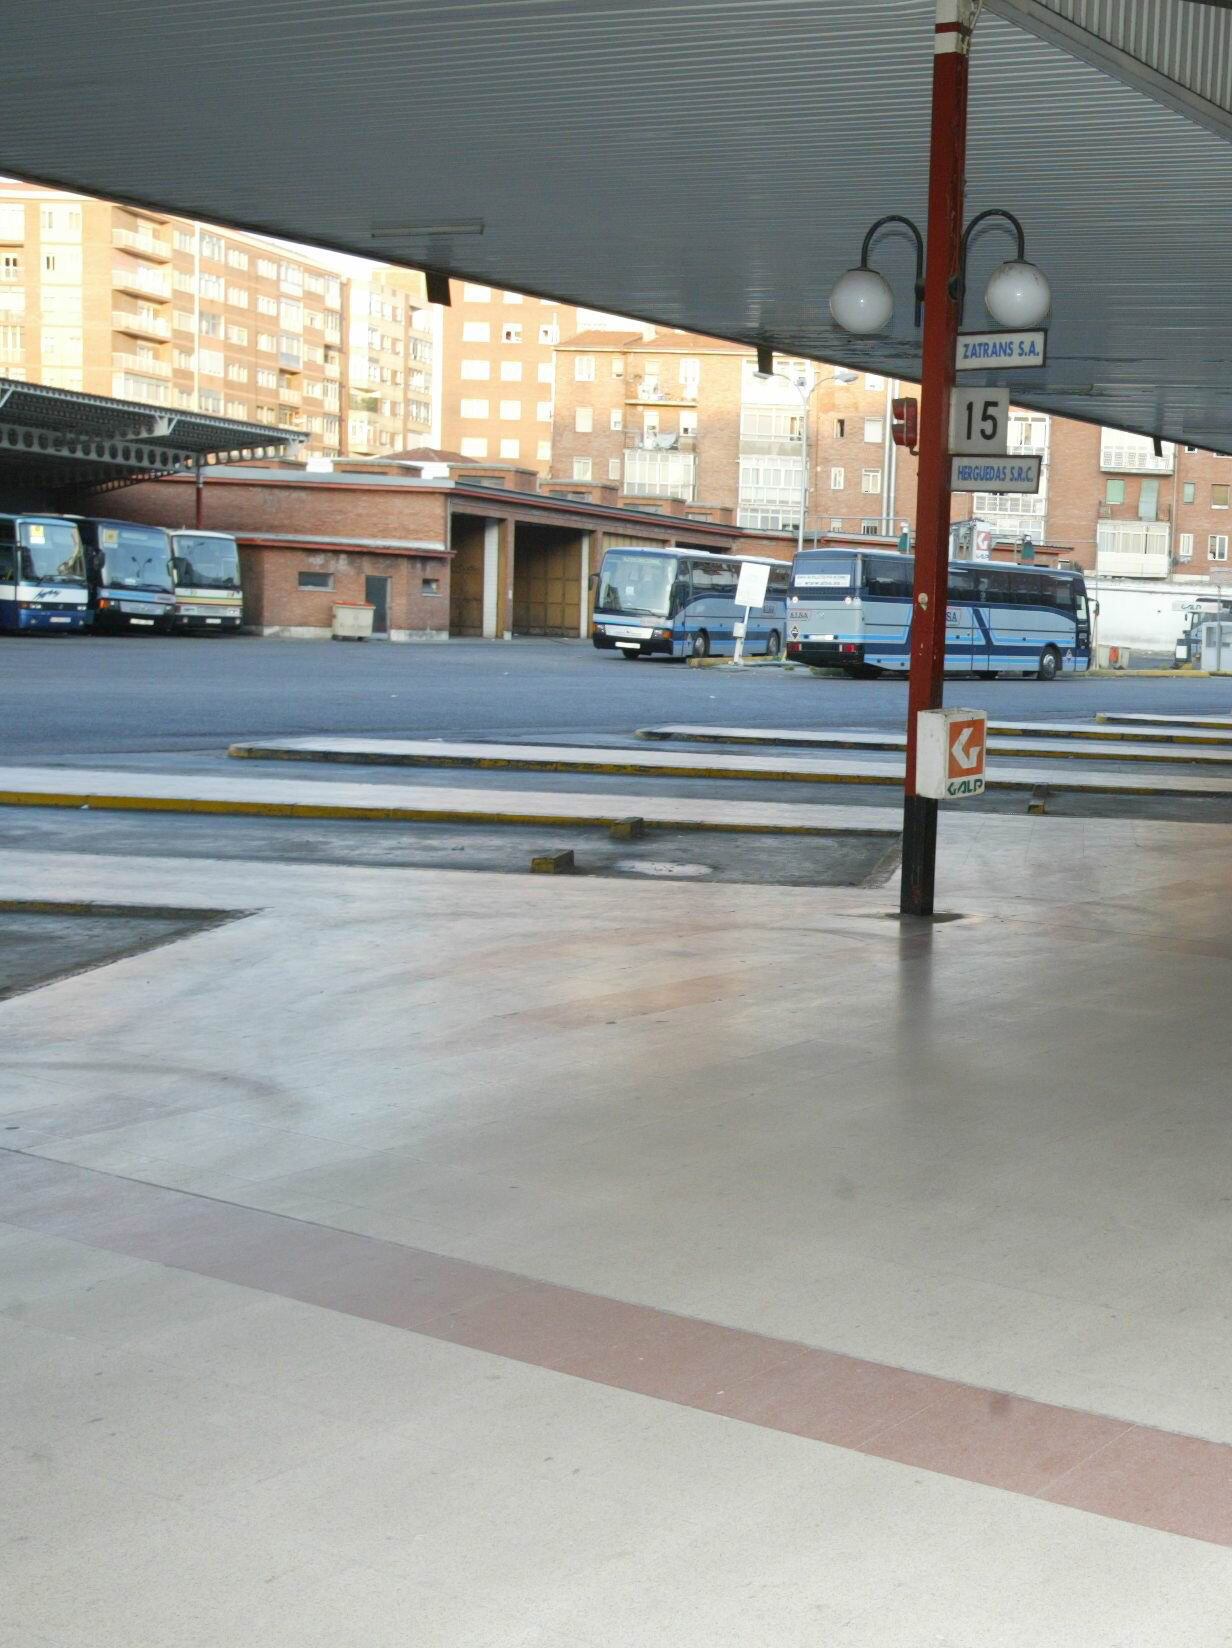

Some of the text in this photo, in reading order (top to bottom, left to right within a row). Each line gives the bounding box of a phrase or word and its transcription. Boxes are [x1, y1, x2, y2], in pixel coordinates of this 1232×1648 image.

[962, 340, 1040, 360] ZATRANS S.A.
[965, 400, 999, 441] 15
[957, 464, 1007, 482] HERGUEDAS
[947, 778, 983, 796] GALP
